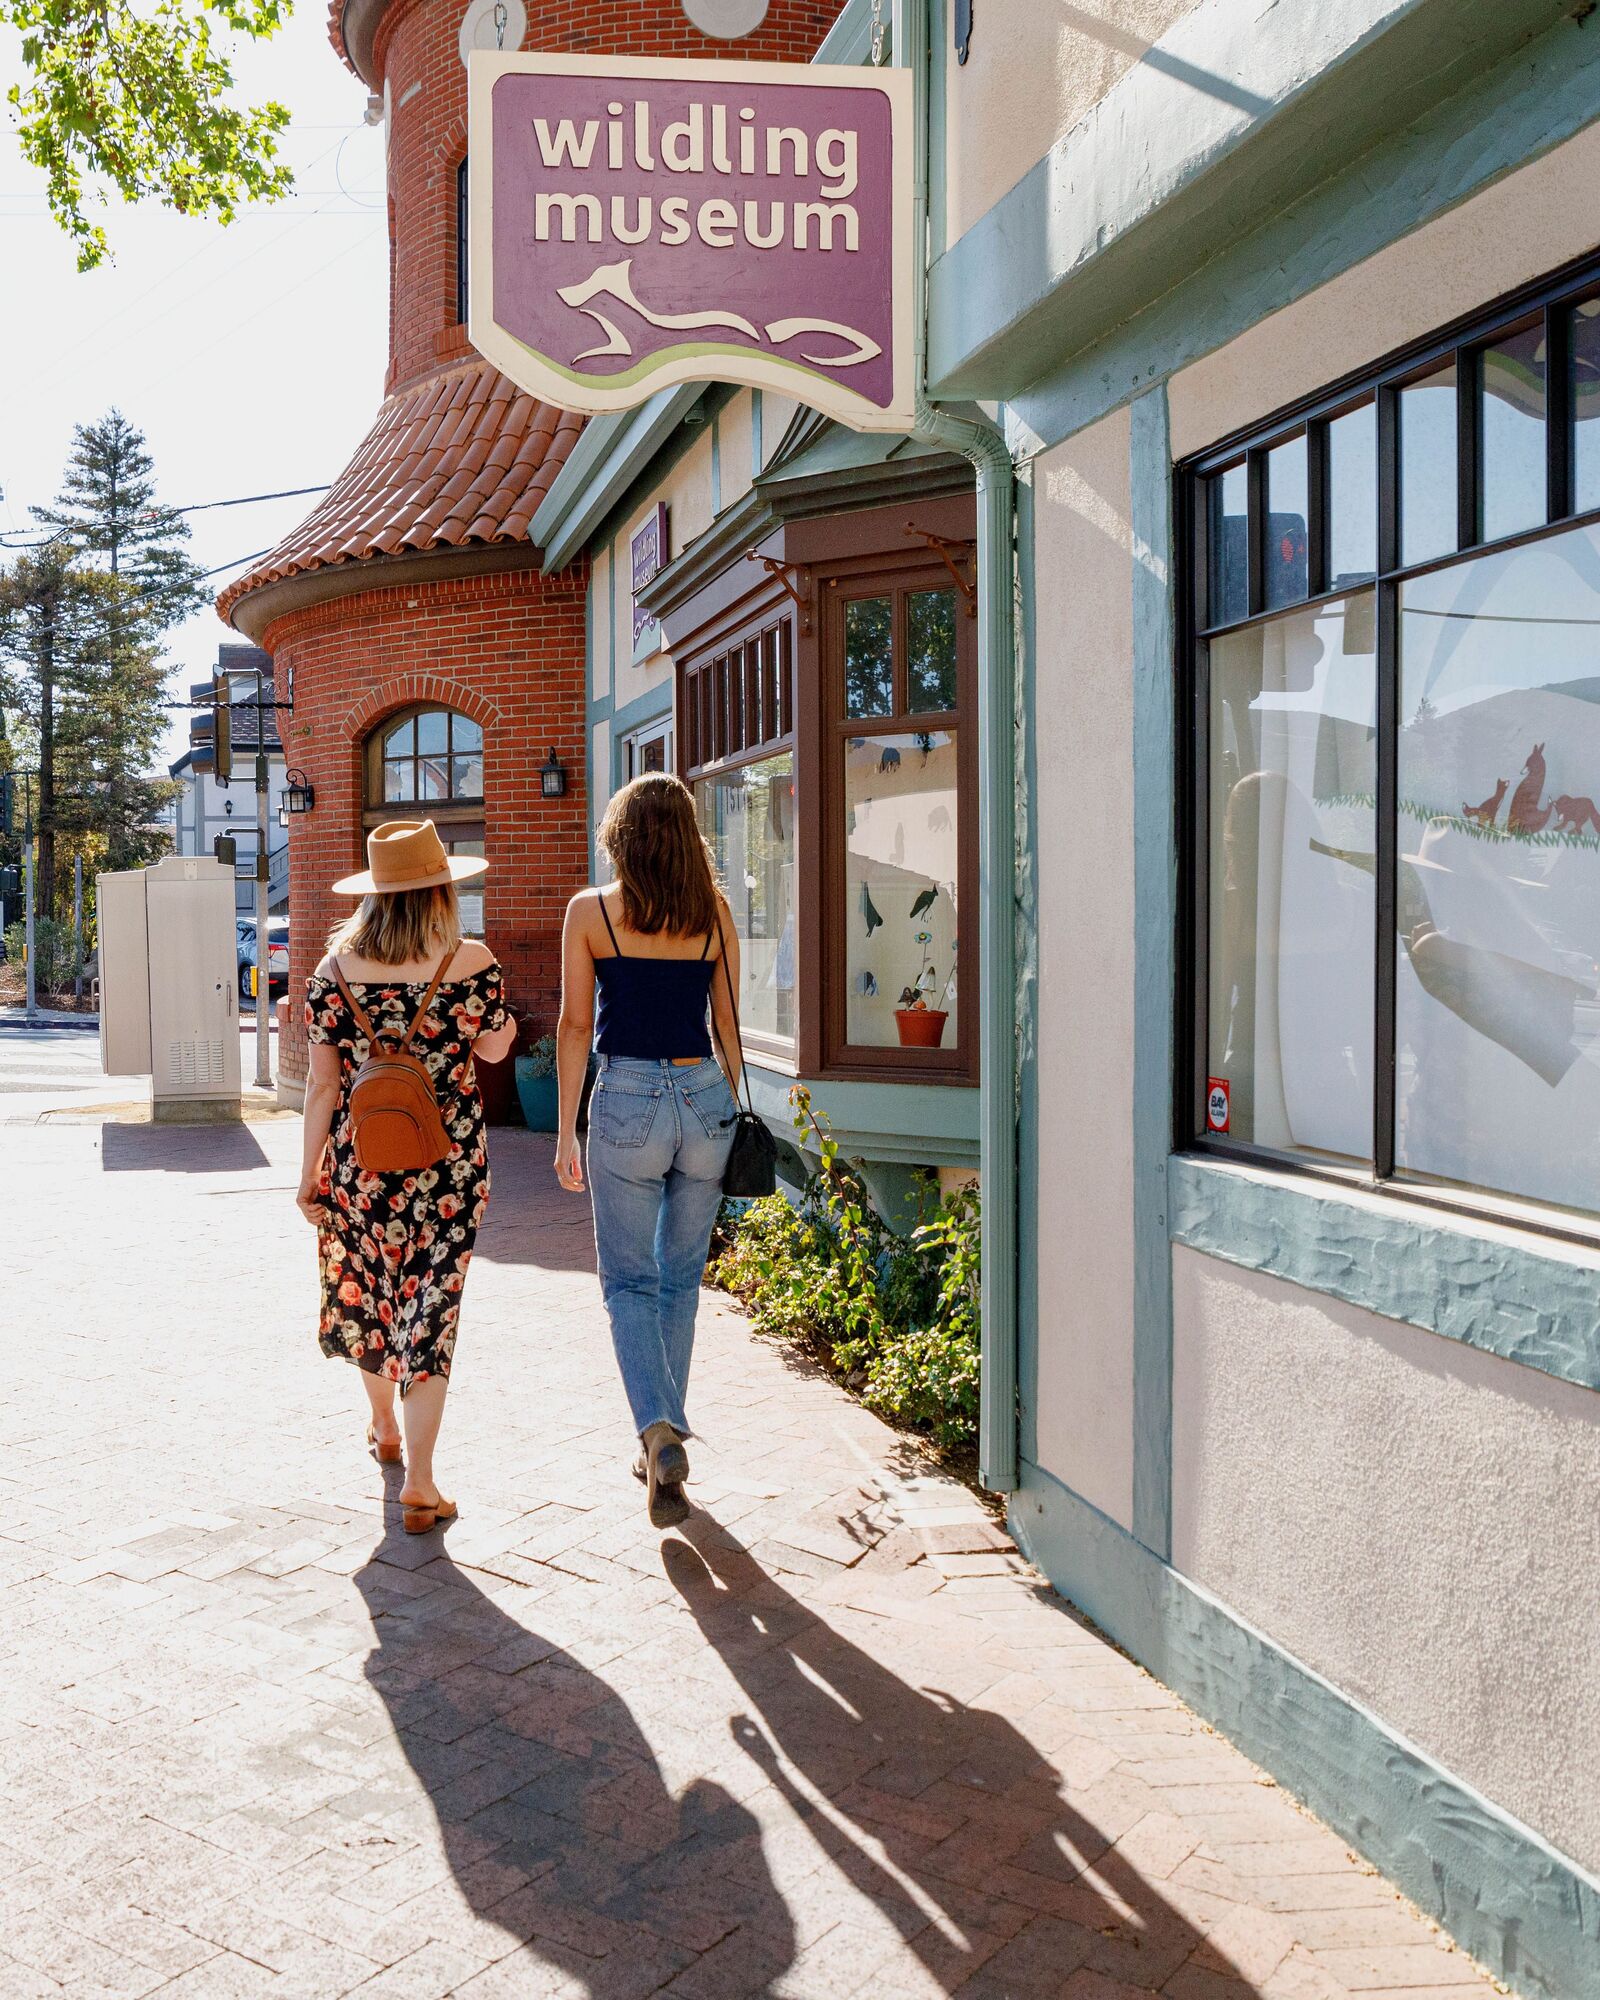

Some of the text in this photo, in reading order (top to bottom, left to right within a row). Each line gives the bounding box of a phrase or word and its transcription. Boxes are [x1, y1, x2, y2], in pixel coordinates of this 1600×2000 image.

[532, 100, 858, 199] wildling
[534, 192, 860, 252] museum
[633, 532, 657, 569] wildling
[1211, 1095, 1226, 1109] BAY
